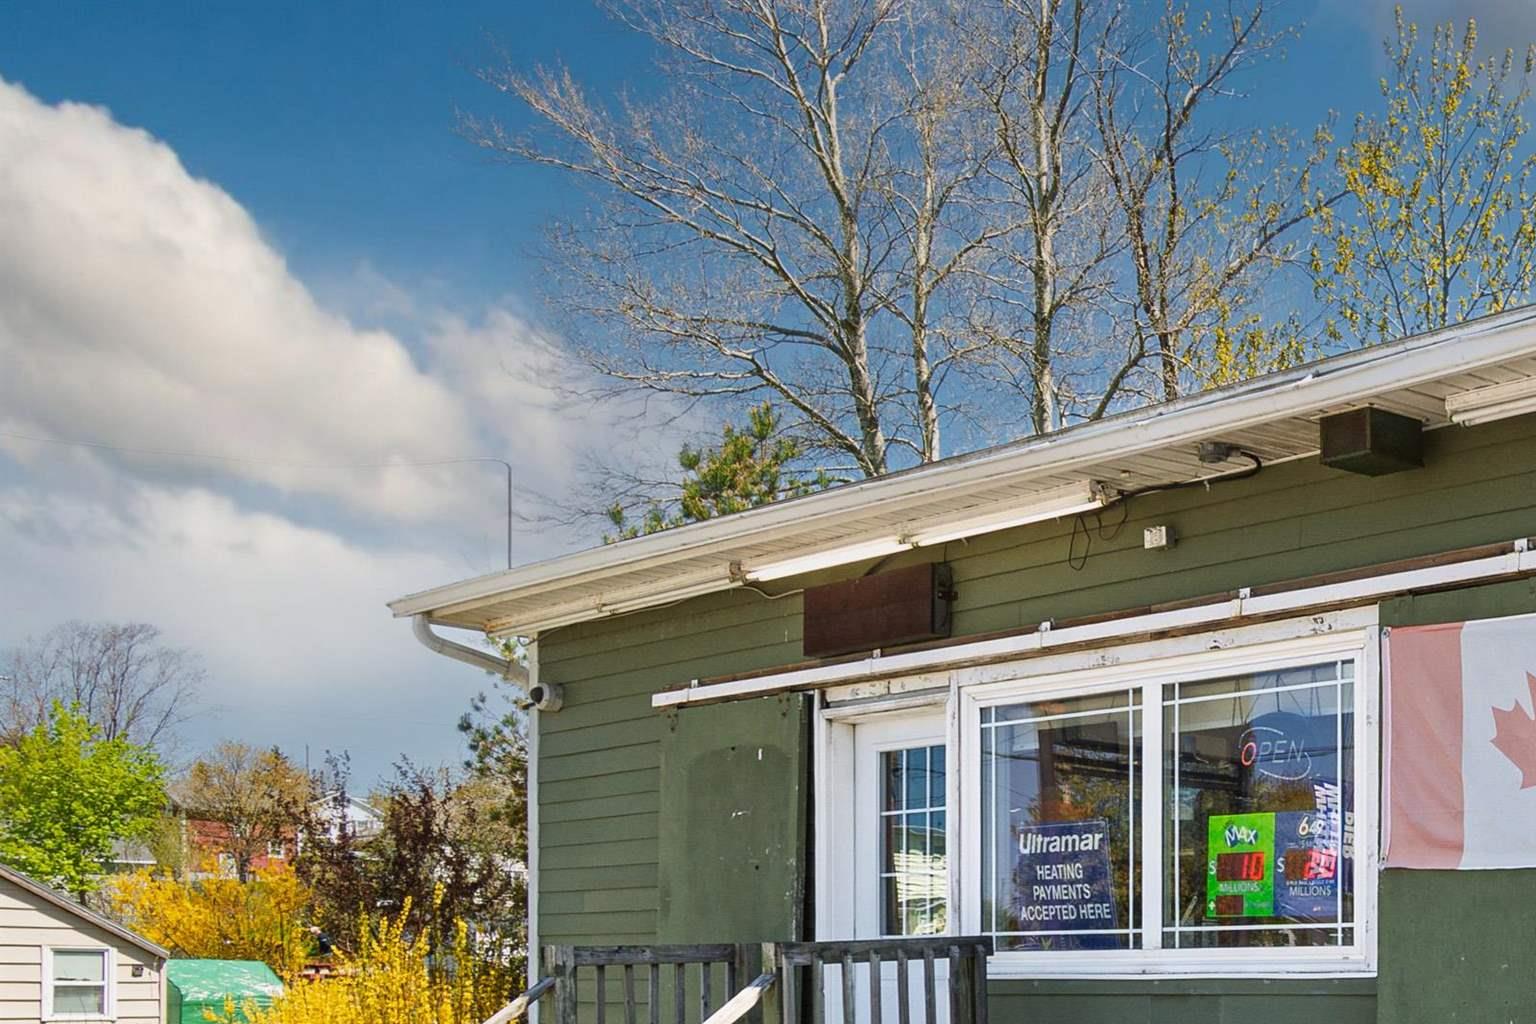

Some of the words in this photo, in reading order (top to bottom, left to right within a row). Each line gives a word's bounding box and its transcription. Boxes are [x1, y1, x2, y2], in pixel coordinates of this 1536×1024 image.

[1241, 739, 1305, 767] OPEN
[1019, 833, 1104, 854] Ultramar
[1225, 825, 1257, 847] MAX
[1036, 863, 1084, 880] HEATING
[1033, 883, 1091, 901] PAYMENTS
[1289, 885, 1332, 897] MILLIONS
[1021, 904, 1077, 921] ACCEPTED
[1079, 903, 1112, 919] HERE
